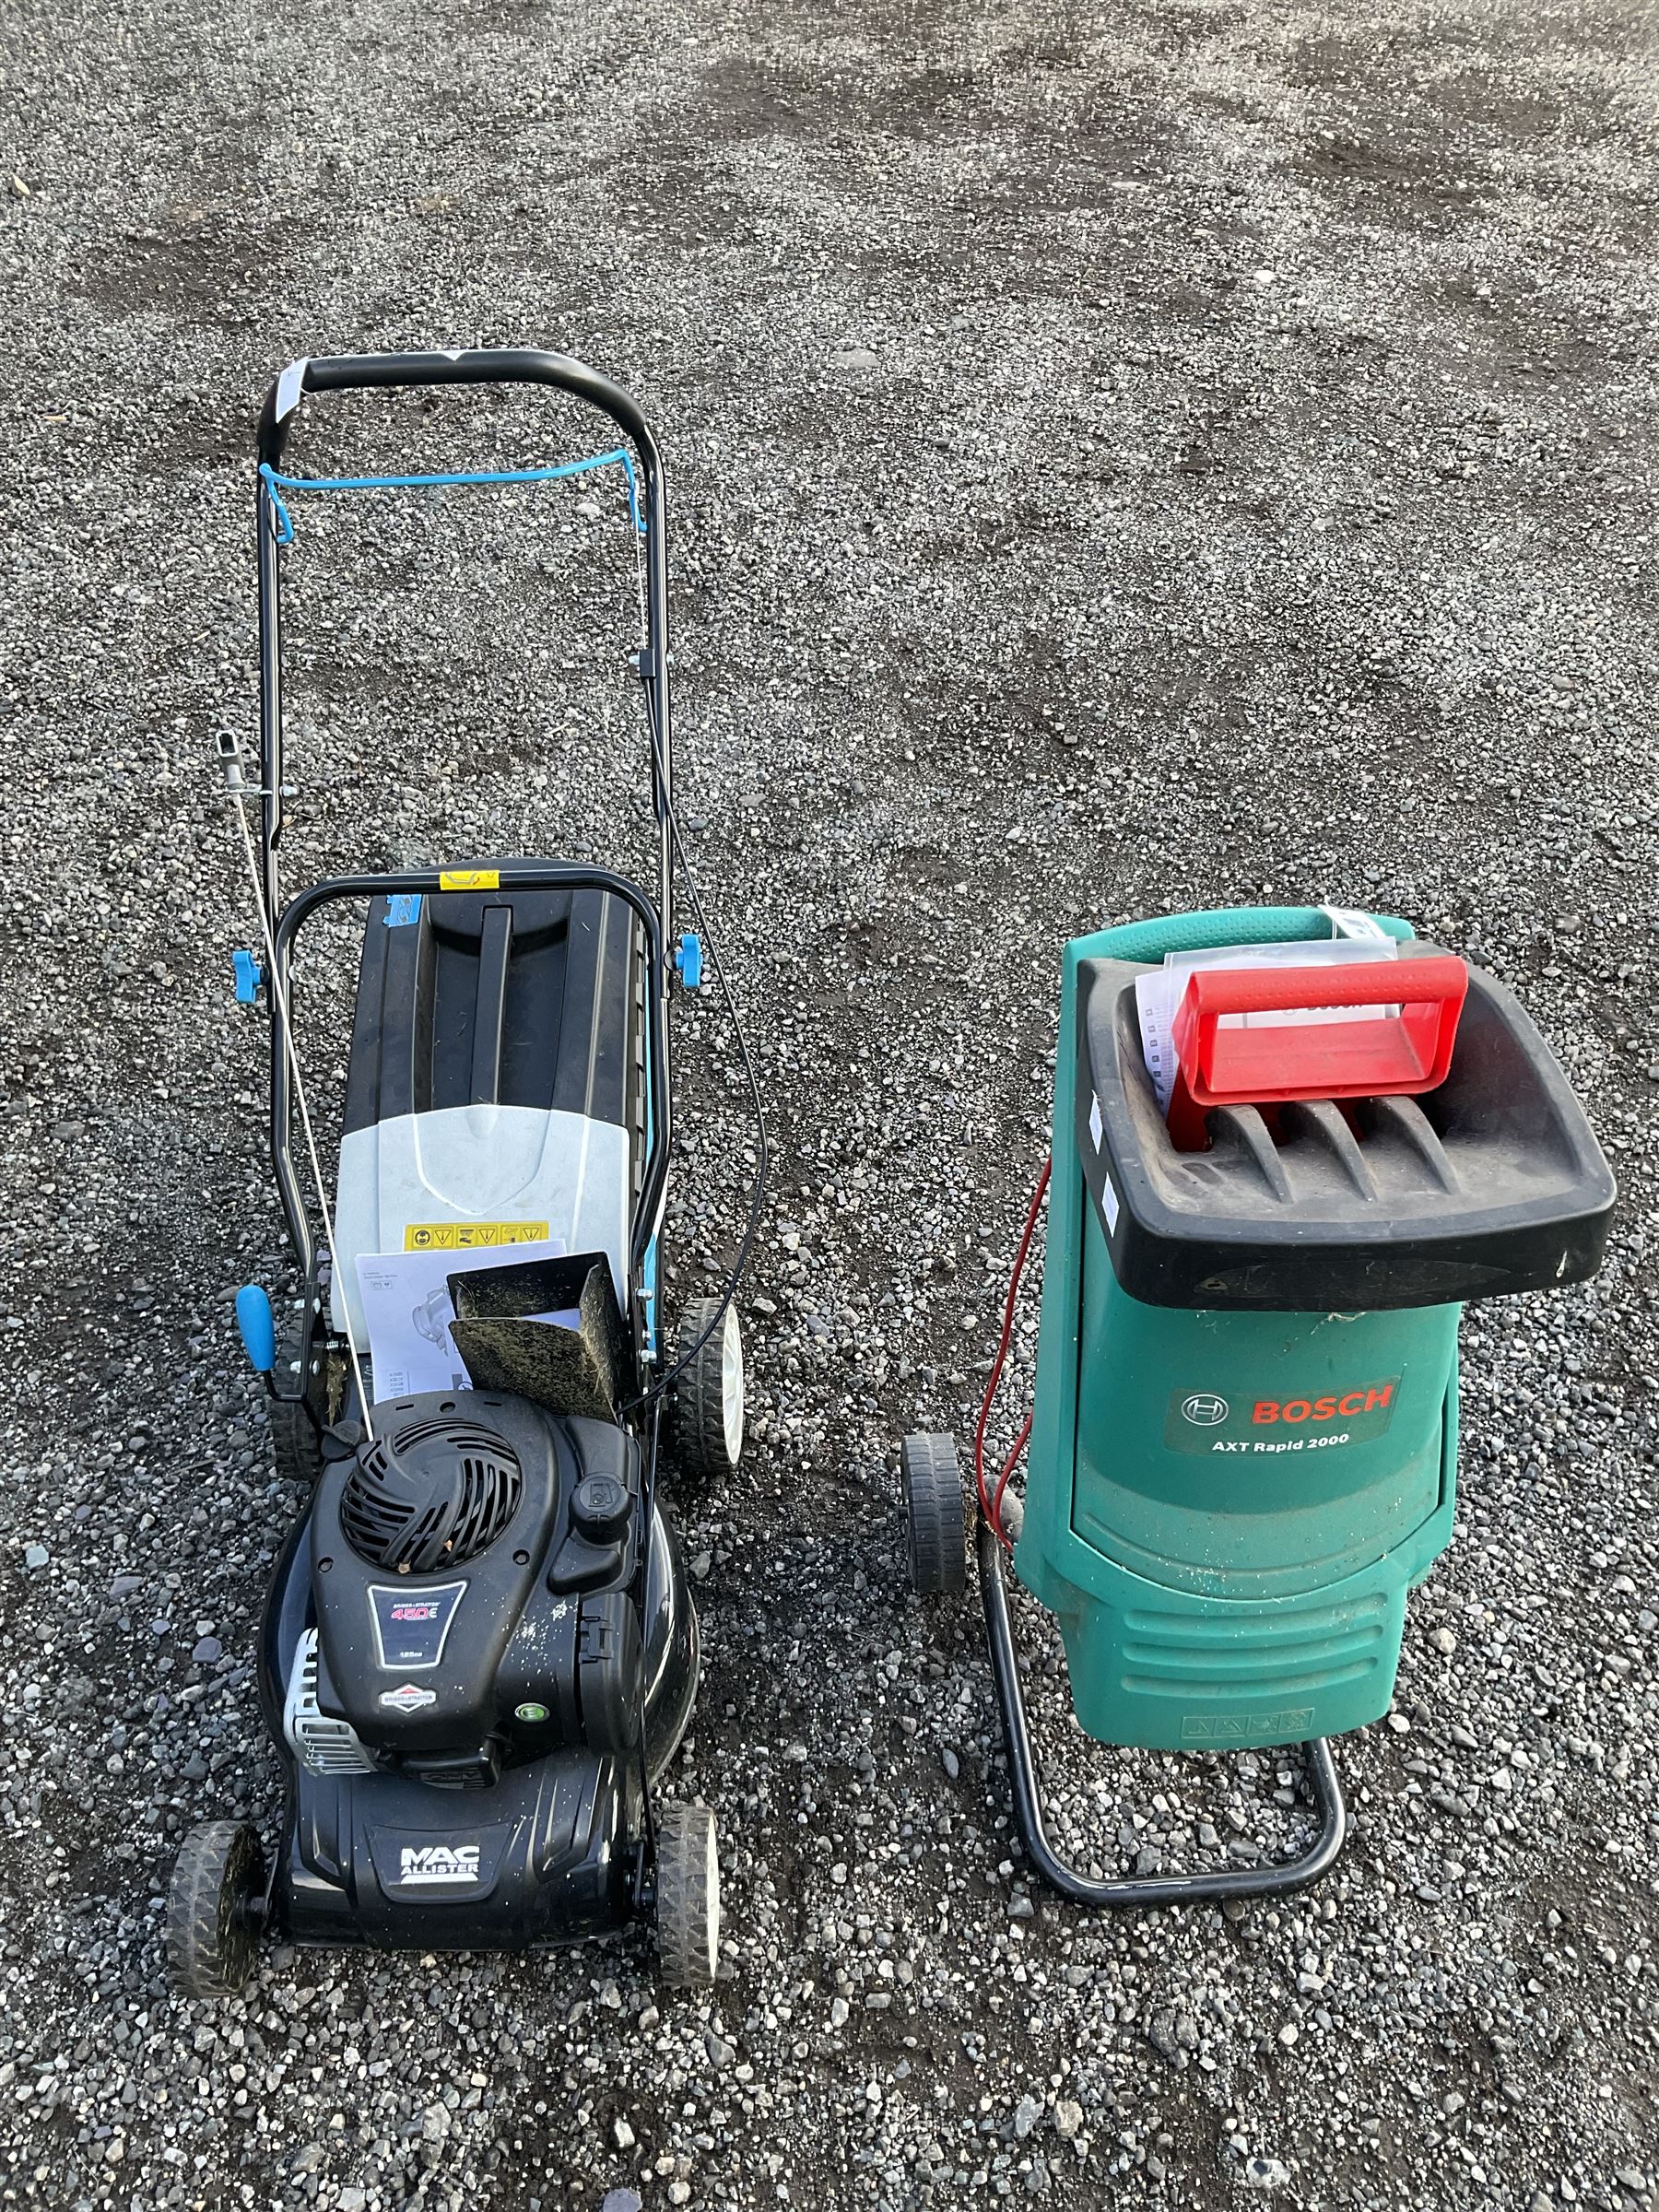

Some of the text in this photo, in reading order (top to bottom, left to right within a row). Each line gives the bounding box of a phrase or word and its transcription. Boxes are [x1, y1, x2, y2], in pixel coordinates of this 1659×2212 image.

[1252, 1383, 1393, 1424] BOSCH
[1211, 1433, 1349, 1453] AXT Rapid 2000
[400, 1845, 480, 1866] MAC
[400, 1864, 479, 1876] ALLISTER
